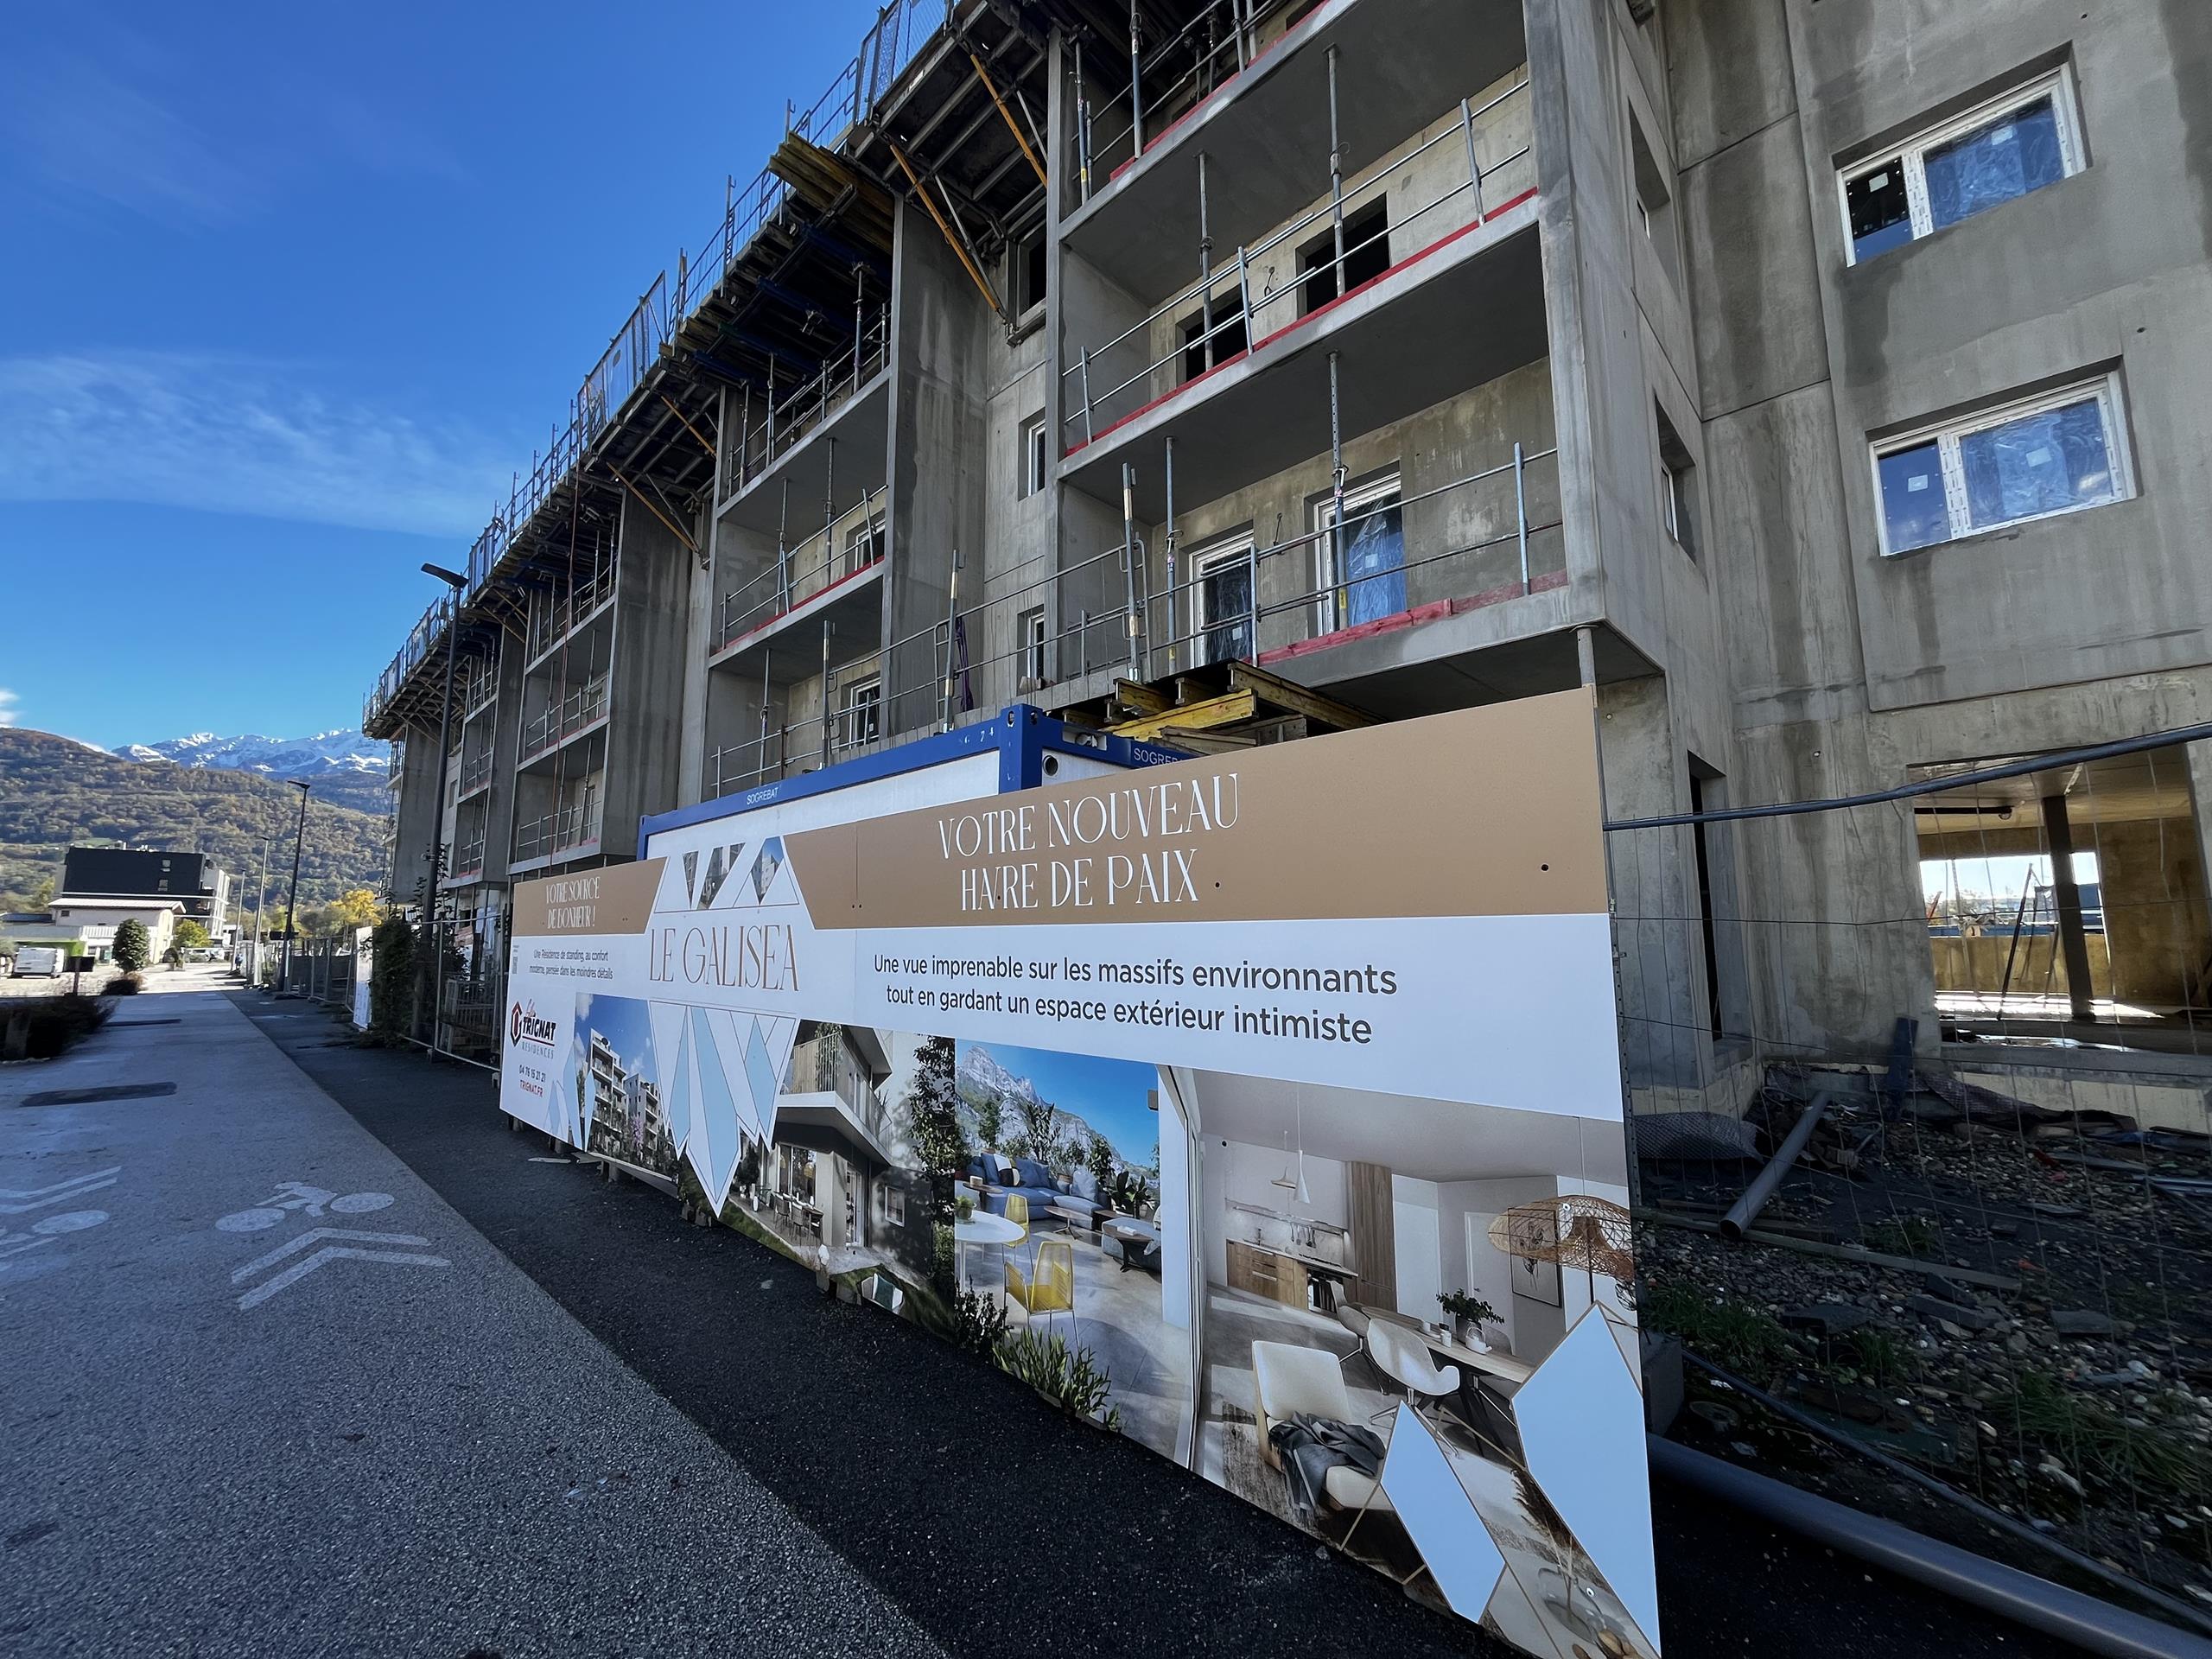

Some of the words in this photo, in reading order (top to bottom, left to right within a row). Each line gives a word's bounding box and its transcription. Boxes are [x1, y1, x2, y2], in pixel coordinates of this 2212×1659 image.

[1134, 748, 1183, 765] SOGRE
[747, 786, 779, 805] SOGREBAT
[938, 804, 1036, 859] VOTRE
[1047, 772, 1238, 849] NOUVEAU
[546, 881, 569, 904] VOTRE
[569, 876, 601, 901] SOURCE
[961, 862, 1038, 912] HAVRE
[1051, 858, 1093, 907] DE
[1107, 849, 1199, 906] PAIX
[547, 908, 556, 929] DE
[557, 906, 590, 929] BONHEUR
[591, 950, 608, 962] confort
[649, 928, 677, 982] LE
[683, 924, 799, 992] GALISEA
[576, 967, 596, 978] moindres
[874, 954, 899, 974] Une
[903, 957, 928, 976] vue
[931, 955, 1024, 980] imprenable
[1028, 961, 1058, 981] sur
[1063, 957, 1092, 982] les
[1097, 958, 1185, 986] massifs
[1192, 961, 1397, 995] environnants
[886, 985, 914, 1005] tout
[918, 988, 937, 1007] en
[939, 988, 1003, 1013] gardant
[1007, 995, 1030, 1014] un
[1036, 996, 1107, 1022] espace
[1113, 998, 1224, 1032] extérieur
[1233, 1004, 1372, 1045] intimiste
[523, 1016, 556, 1041] TRIGNAT
[520, 1079, 543, 1097] TRIGNAT.FR
